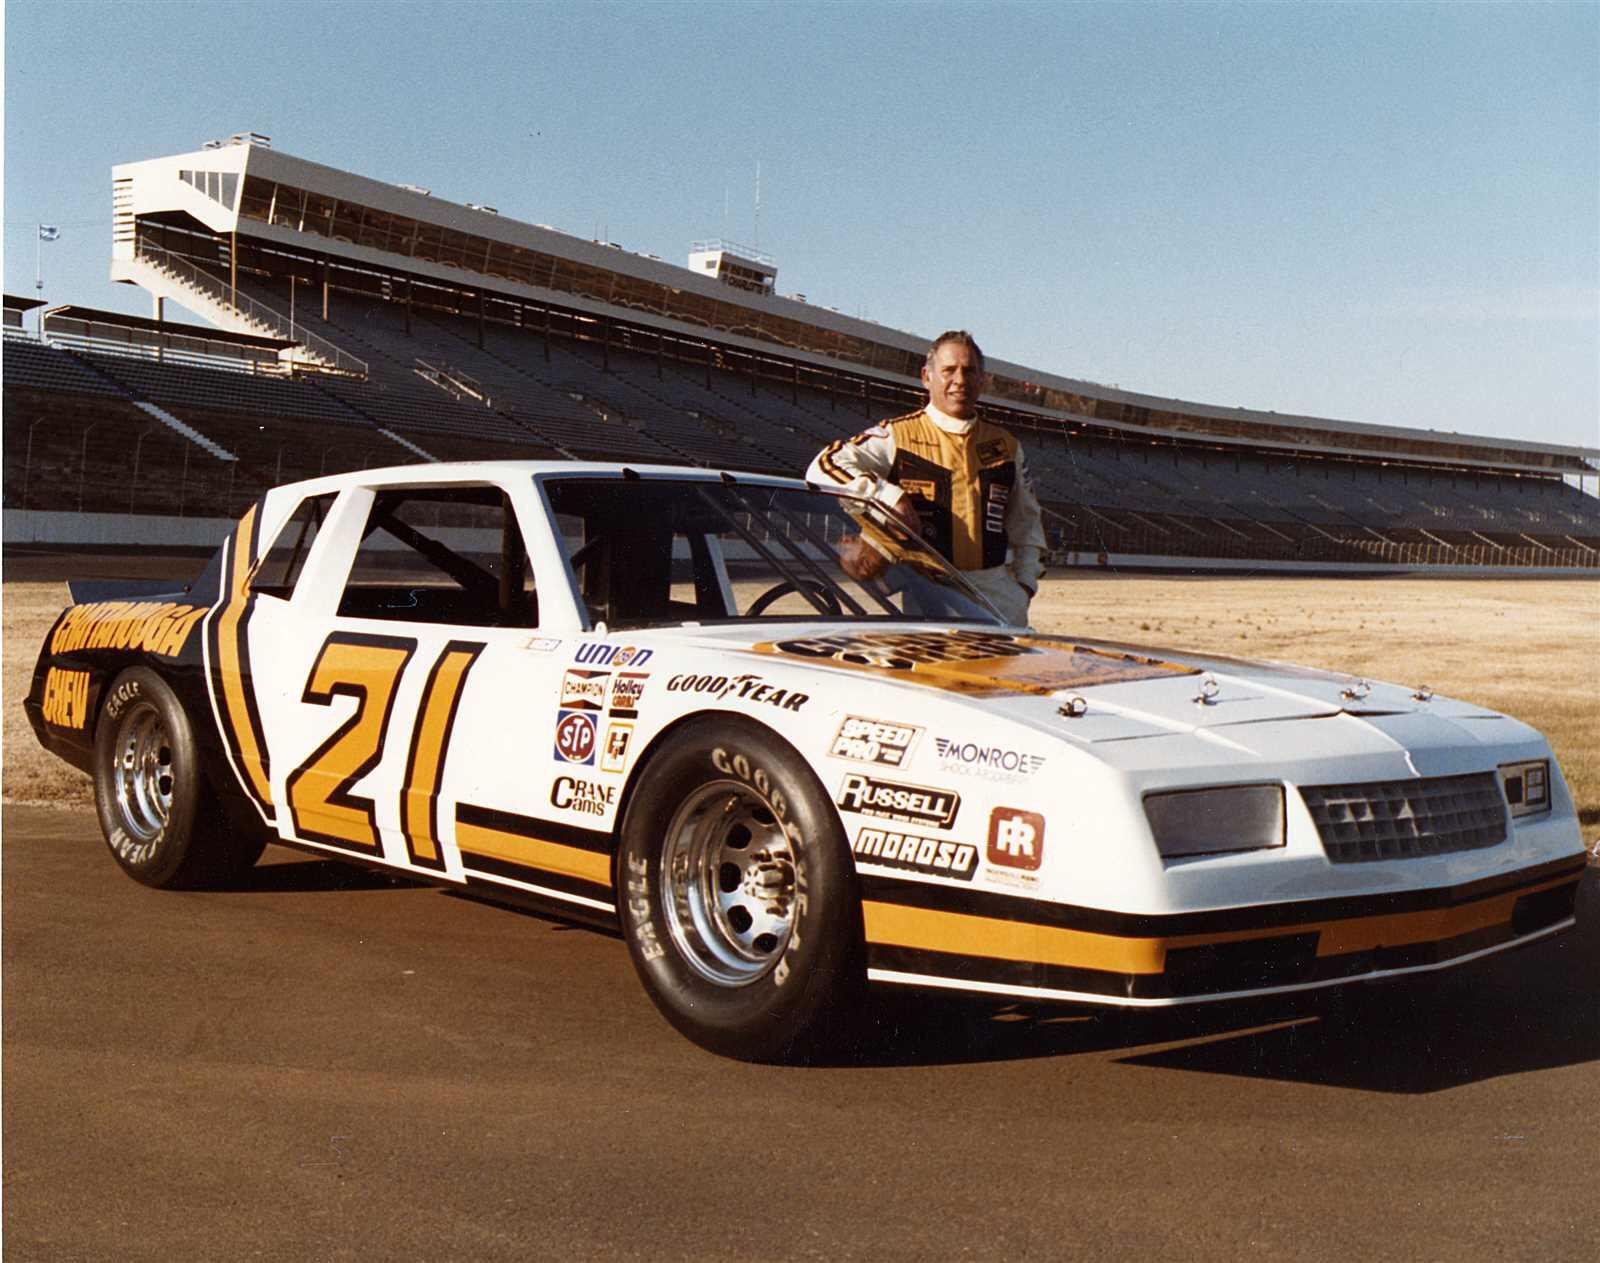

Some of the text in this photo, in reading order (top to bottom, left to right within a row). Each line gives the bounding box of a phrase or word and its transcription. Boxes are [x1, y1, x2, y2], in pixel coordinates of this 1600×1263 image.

[106, 681, 141, 719] EAGLE
[612, 679, 645, 700] Holley
[286, 629, 488, 873] 21
[561, 718, 591, 753] STP
[832, 736, 881, 762] PRO
[841, 719, 915, 748] SPEED
[945, 743, 1029, 774] MONROE
[855, 829, 976, 873] MOROSO
[627, 851, 665, 963] EAGLE
